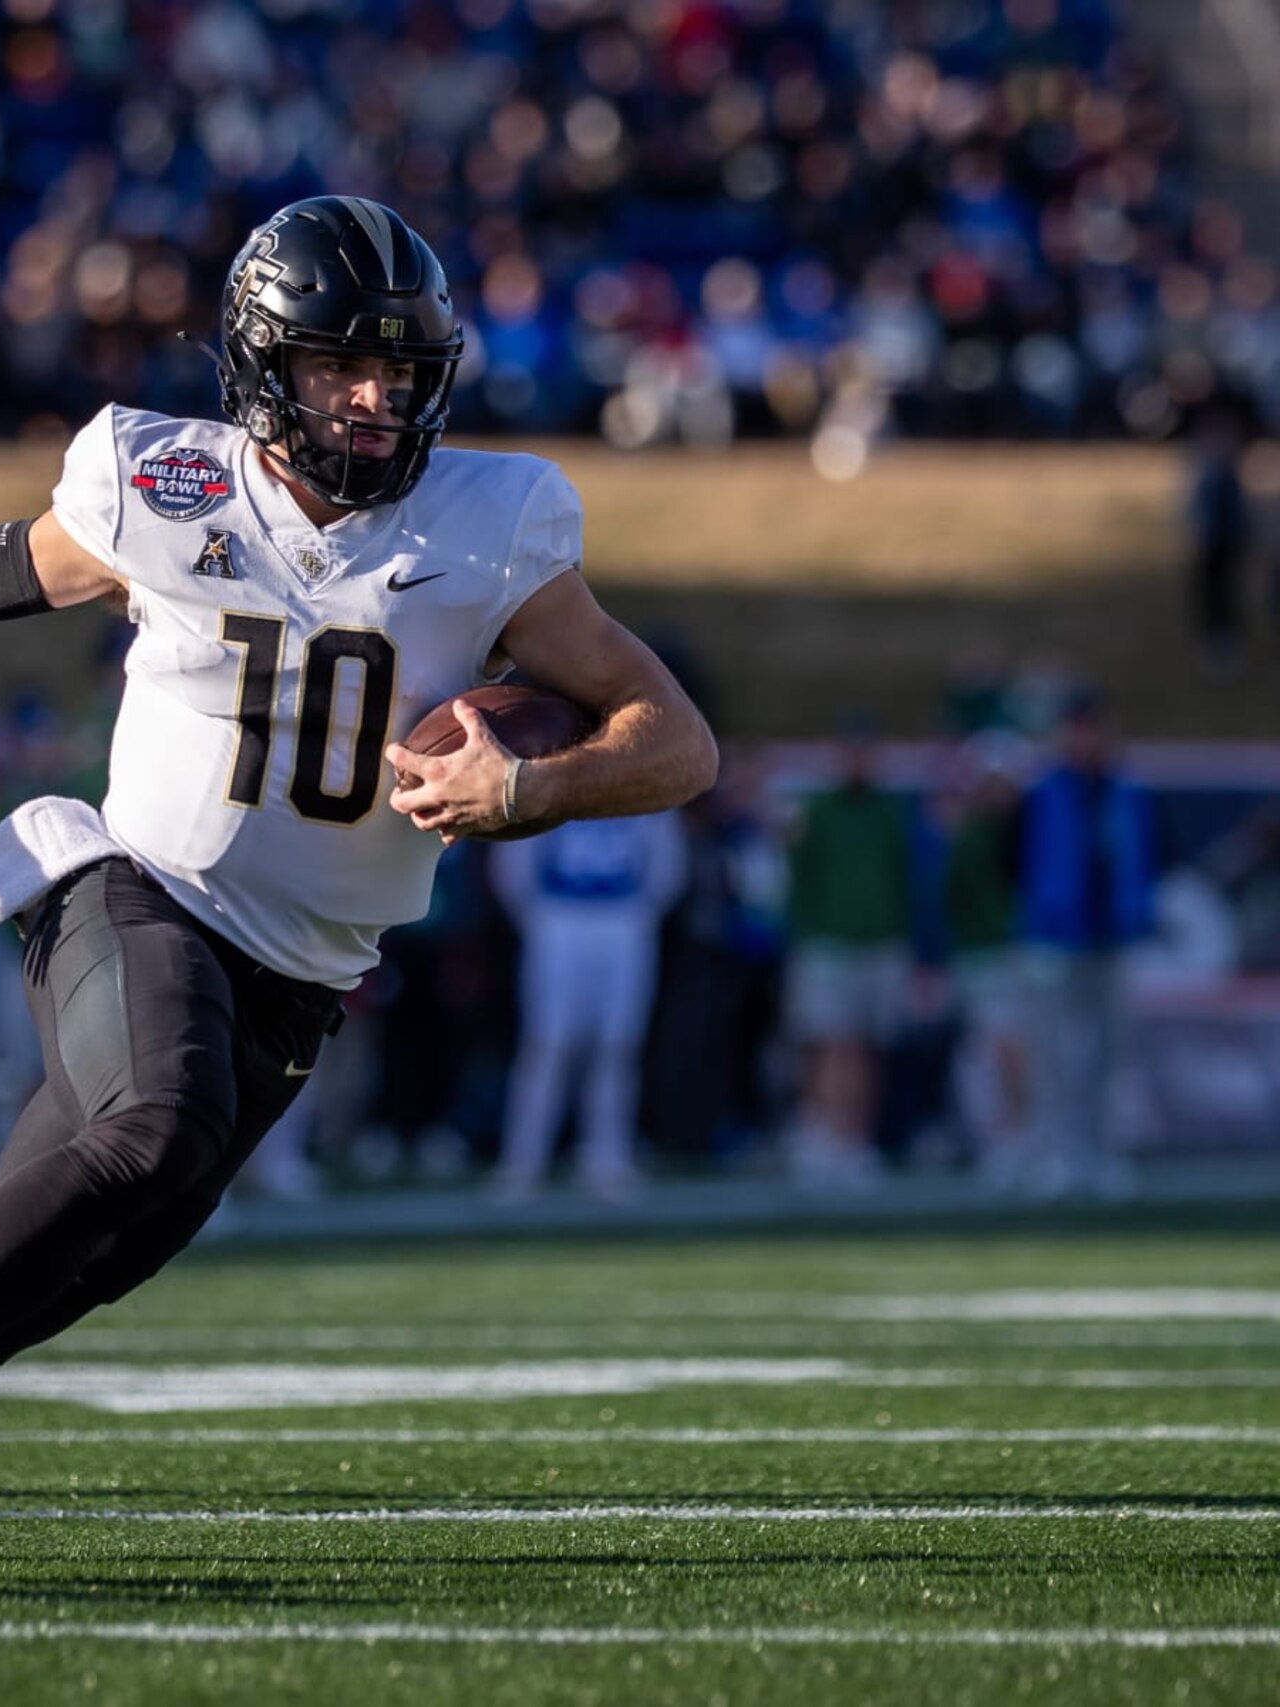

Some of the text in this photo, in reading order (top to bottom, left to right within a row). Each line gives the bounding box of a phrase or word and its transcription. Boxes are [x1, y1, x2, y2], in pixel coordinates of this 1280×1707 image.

[142, 463, 222, 482] MILITARY
[156, 478, 204, 495] BOWL
[220, 608, 401, 830] 10
